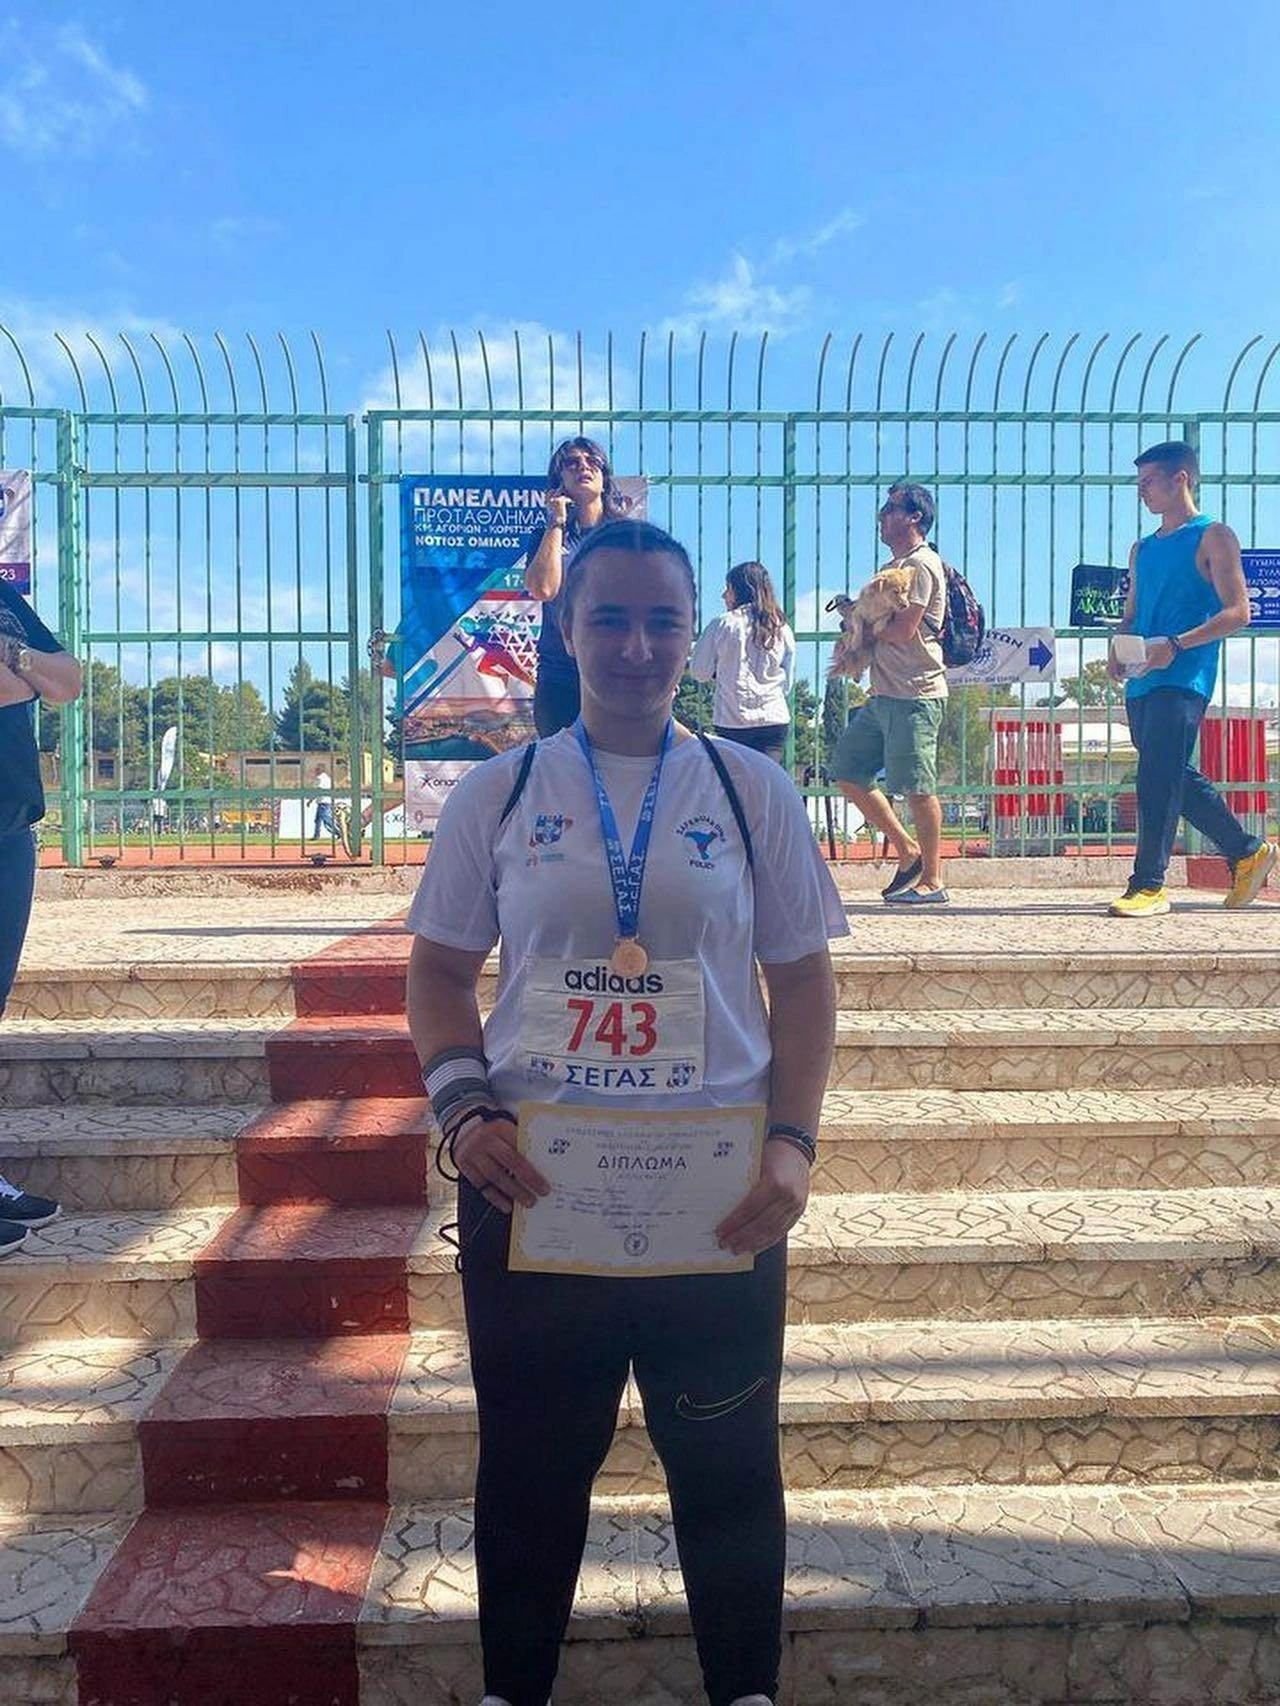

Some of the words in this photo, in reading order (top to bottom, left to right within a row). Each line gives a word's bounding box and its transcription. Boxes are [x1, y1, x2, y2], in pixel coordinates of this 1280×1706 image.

[414, 508, 547, 525] ΠΡΩΤΑΘΛΗΜΑ
[415, 536, 465, 547] ΝΟΤΙΟΣ
[468, 537, 521, 548] ΟΜΙΛΟΣ
[565, 966, 664, 994] adidas
[567, 998, 658, 1057] 743
[565, 1064, 656, 1088] ΣΕΓΑΣ
[597, 1154, 688, 1171] ΔΙΠΛΩΜΑ
